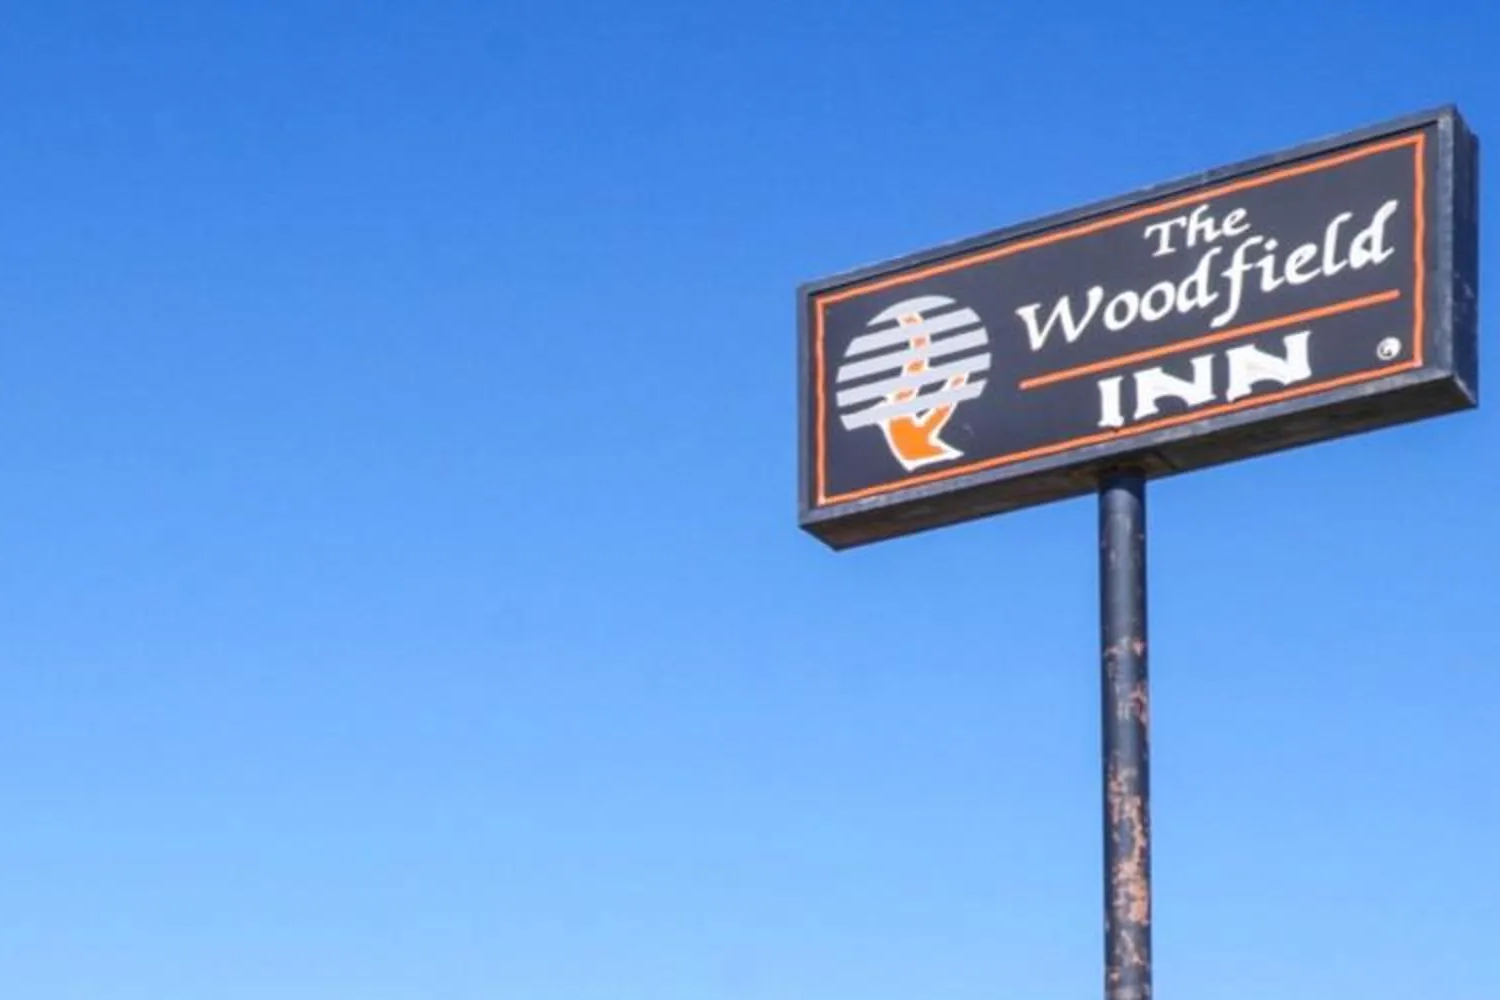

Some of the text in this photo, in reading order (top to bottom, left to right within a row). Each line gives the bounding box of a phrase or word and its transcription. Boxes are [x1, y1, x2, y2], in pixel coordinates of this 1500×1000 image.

[1016, 200, 1398, 351] Woodfield
[1143, 204, 1250, 258] The
[1097, 331, 1312, 427] INN
